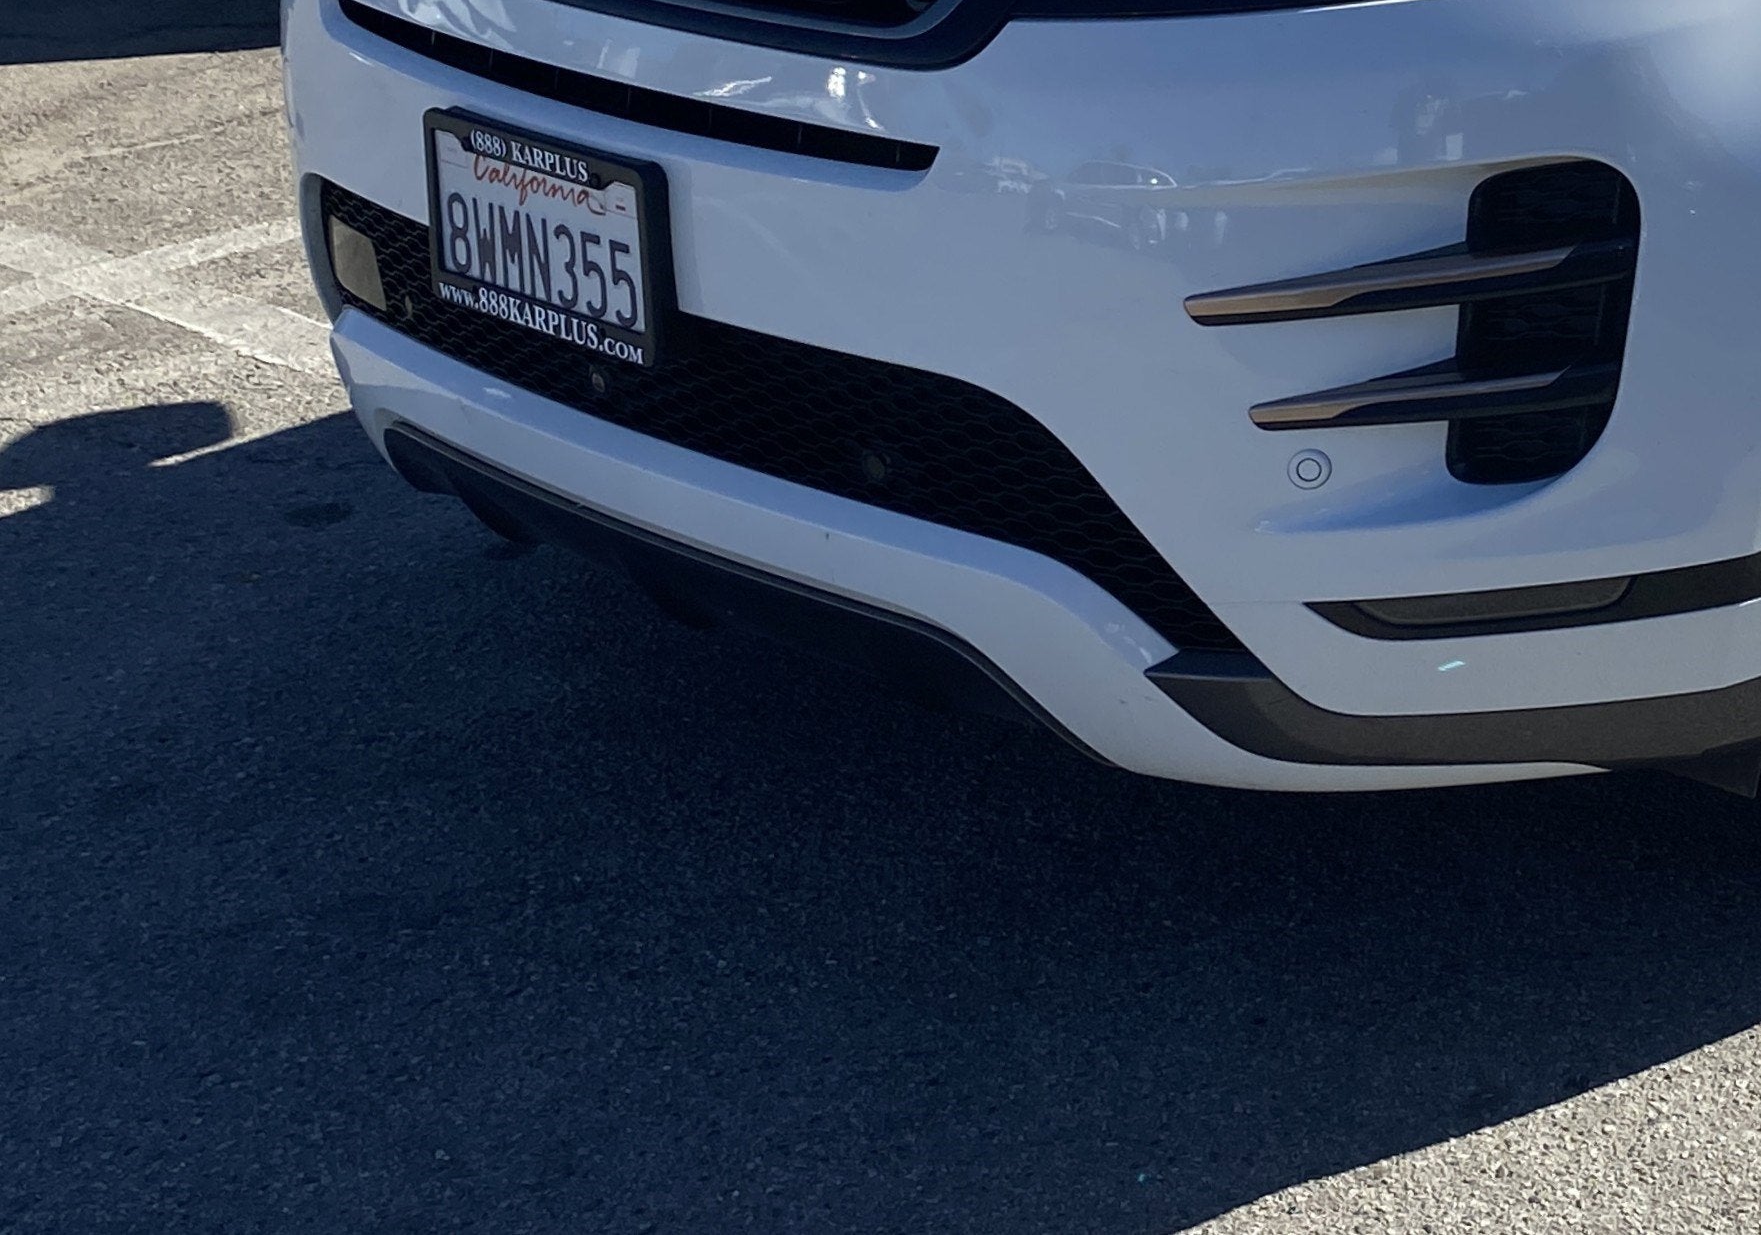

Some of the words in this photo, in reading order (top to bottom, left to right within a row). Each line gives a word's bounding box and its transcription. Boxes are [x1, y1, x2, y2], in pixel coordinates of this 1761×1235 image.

[469, 129, 507, 158] (888)
[510, 140, 589, 183] KARPLUS
[473, 154, 606, 216] California
[447, 192, 639, 328] 8WMN355
